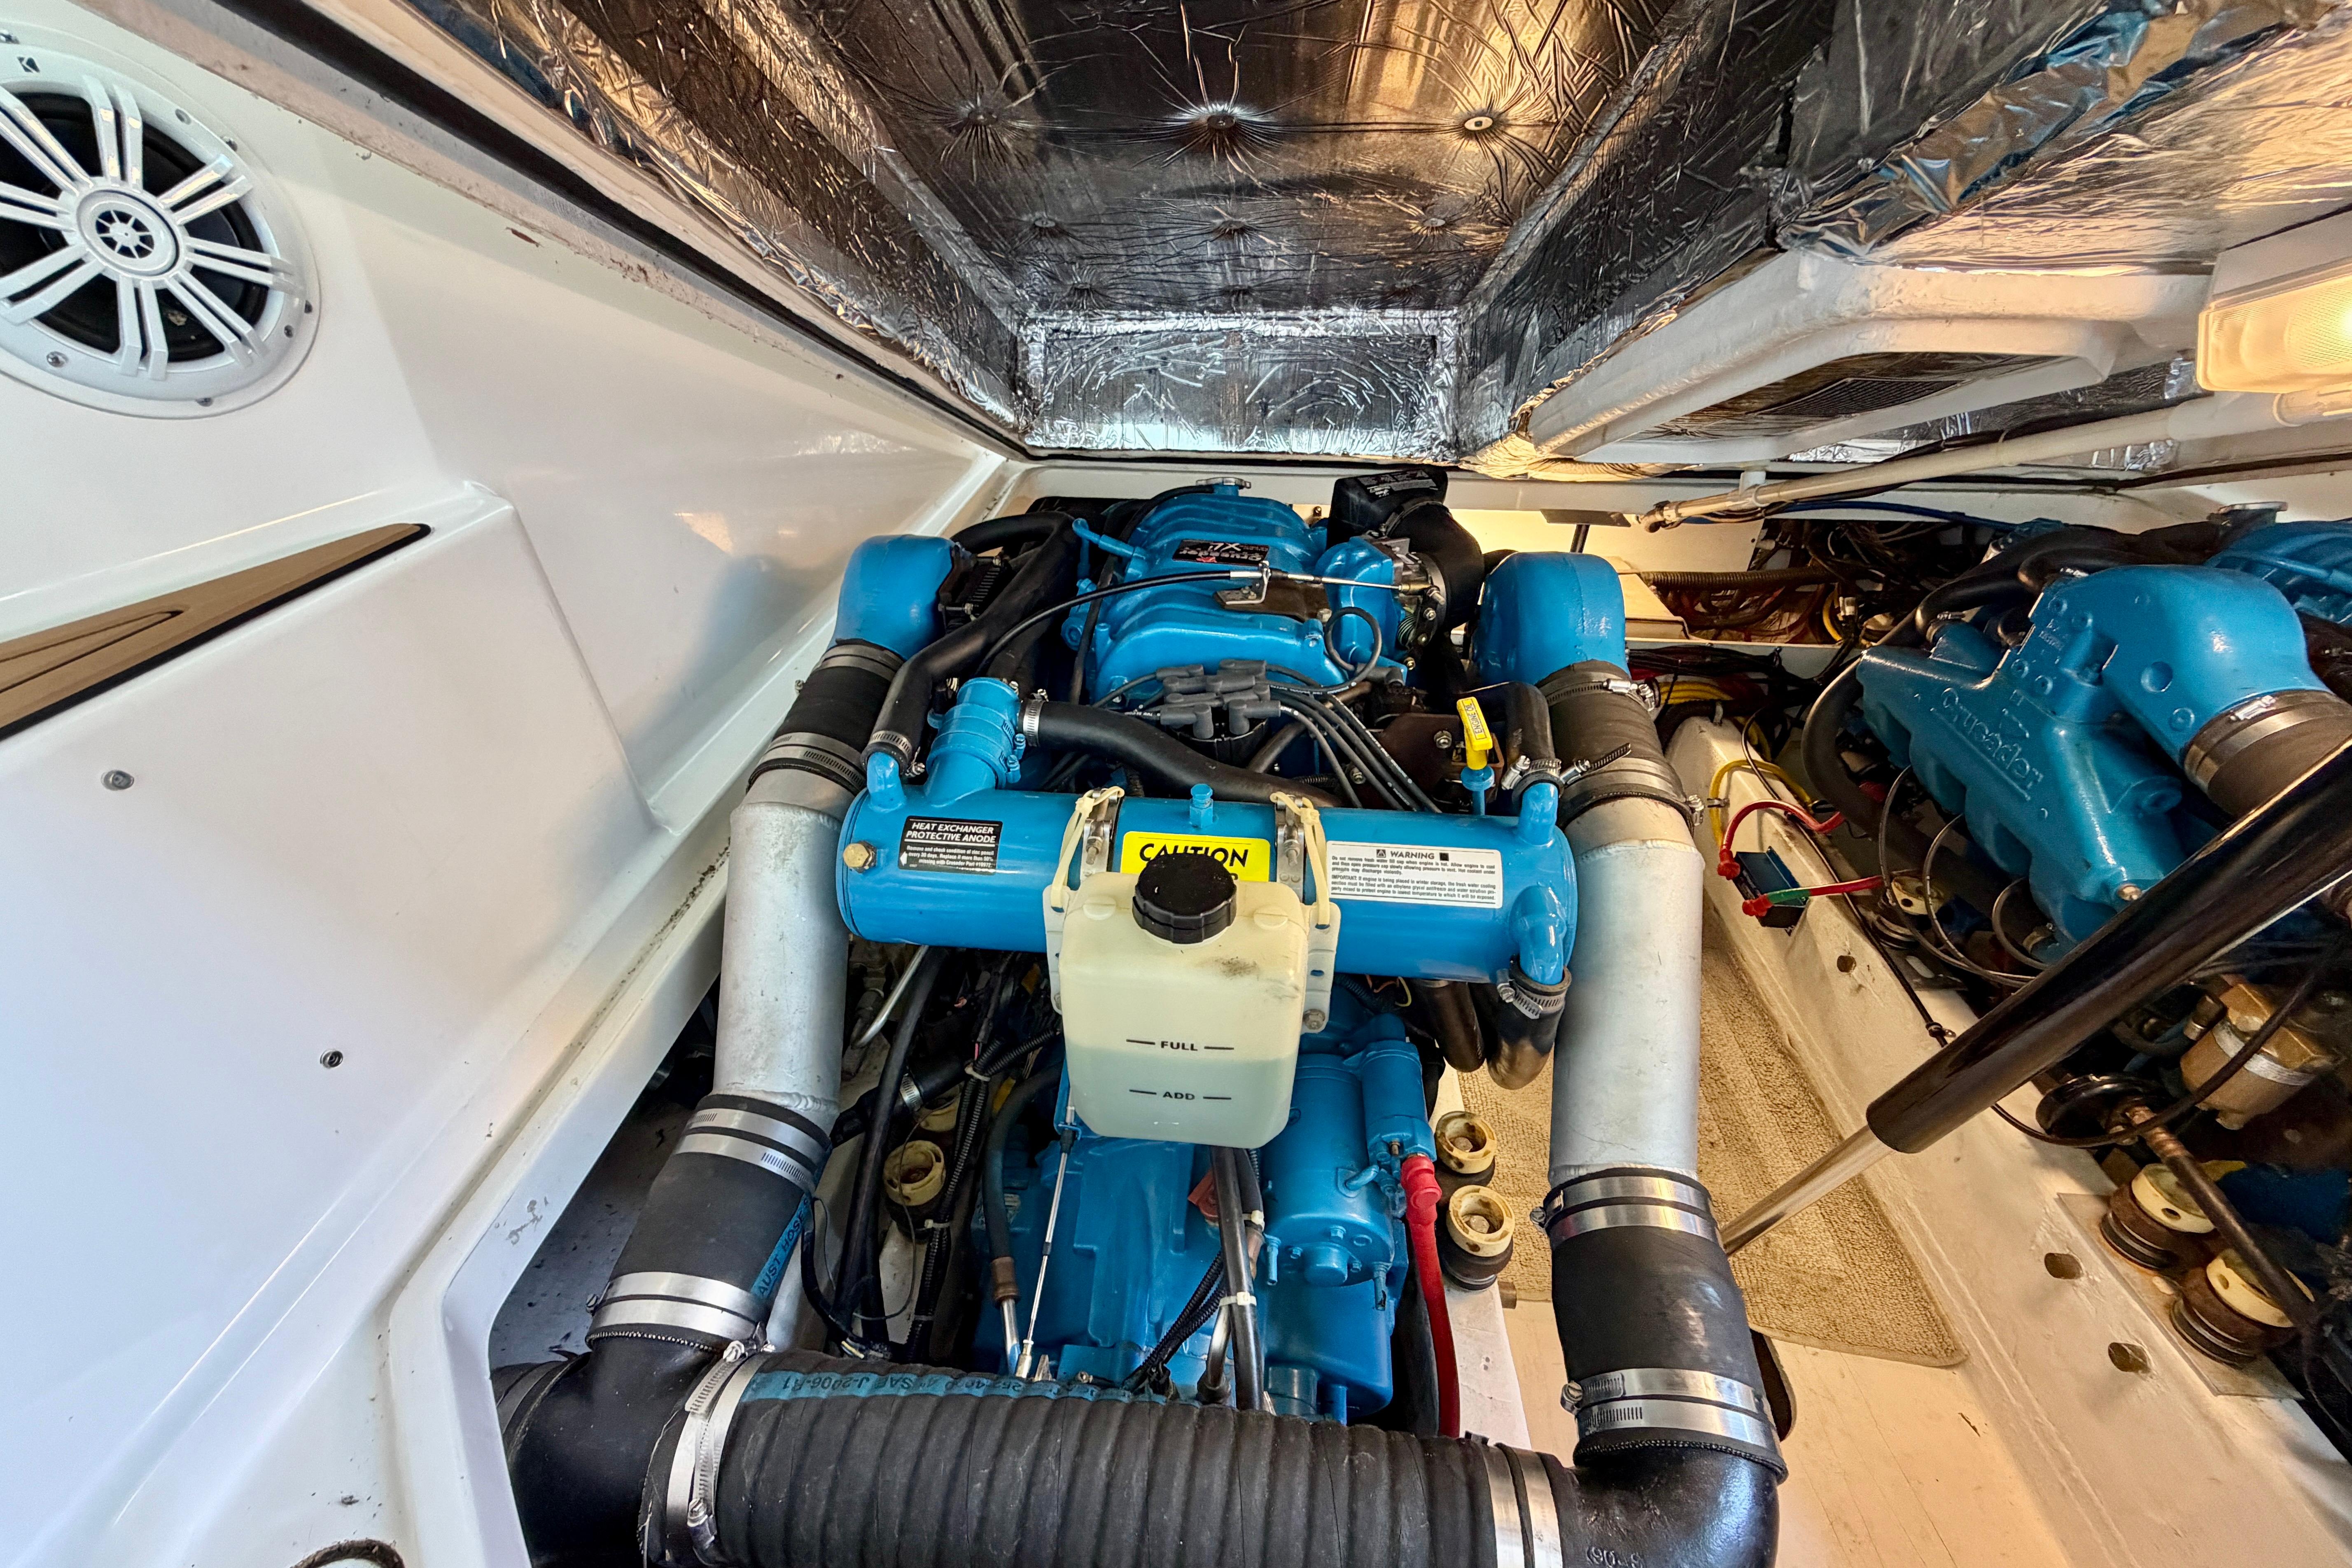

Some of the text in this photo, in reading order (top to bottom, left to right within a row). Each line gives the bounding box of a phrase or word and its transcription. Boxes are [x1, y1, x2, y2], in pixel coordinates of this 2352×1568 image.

[1178, 549, 1262, 561] Crusader
[1467, 712, 1483, 734] ENGINE
[1941, 687, 2044, 789] Crusader
[912, 822, 994, 834] HEAT EXCHANGER
[906, 831, 996, 843] PROTECTIVE ANODE
[1391, 851, 1435, 859] WARNING
[1161, 1041, 1198, 1051] FULL
[1163, 1092, 1195, 1100] ADD
[783, 1375, 870, 1391] J-2006-R1
